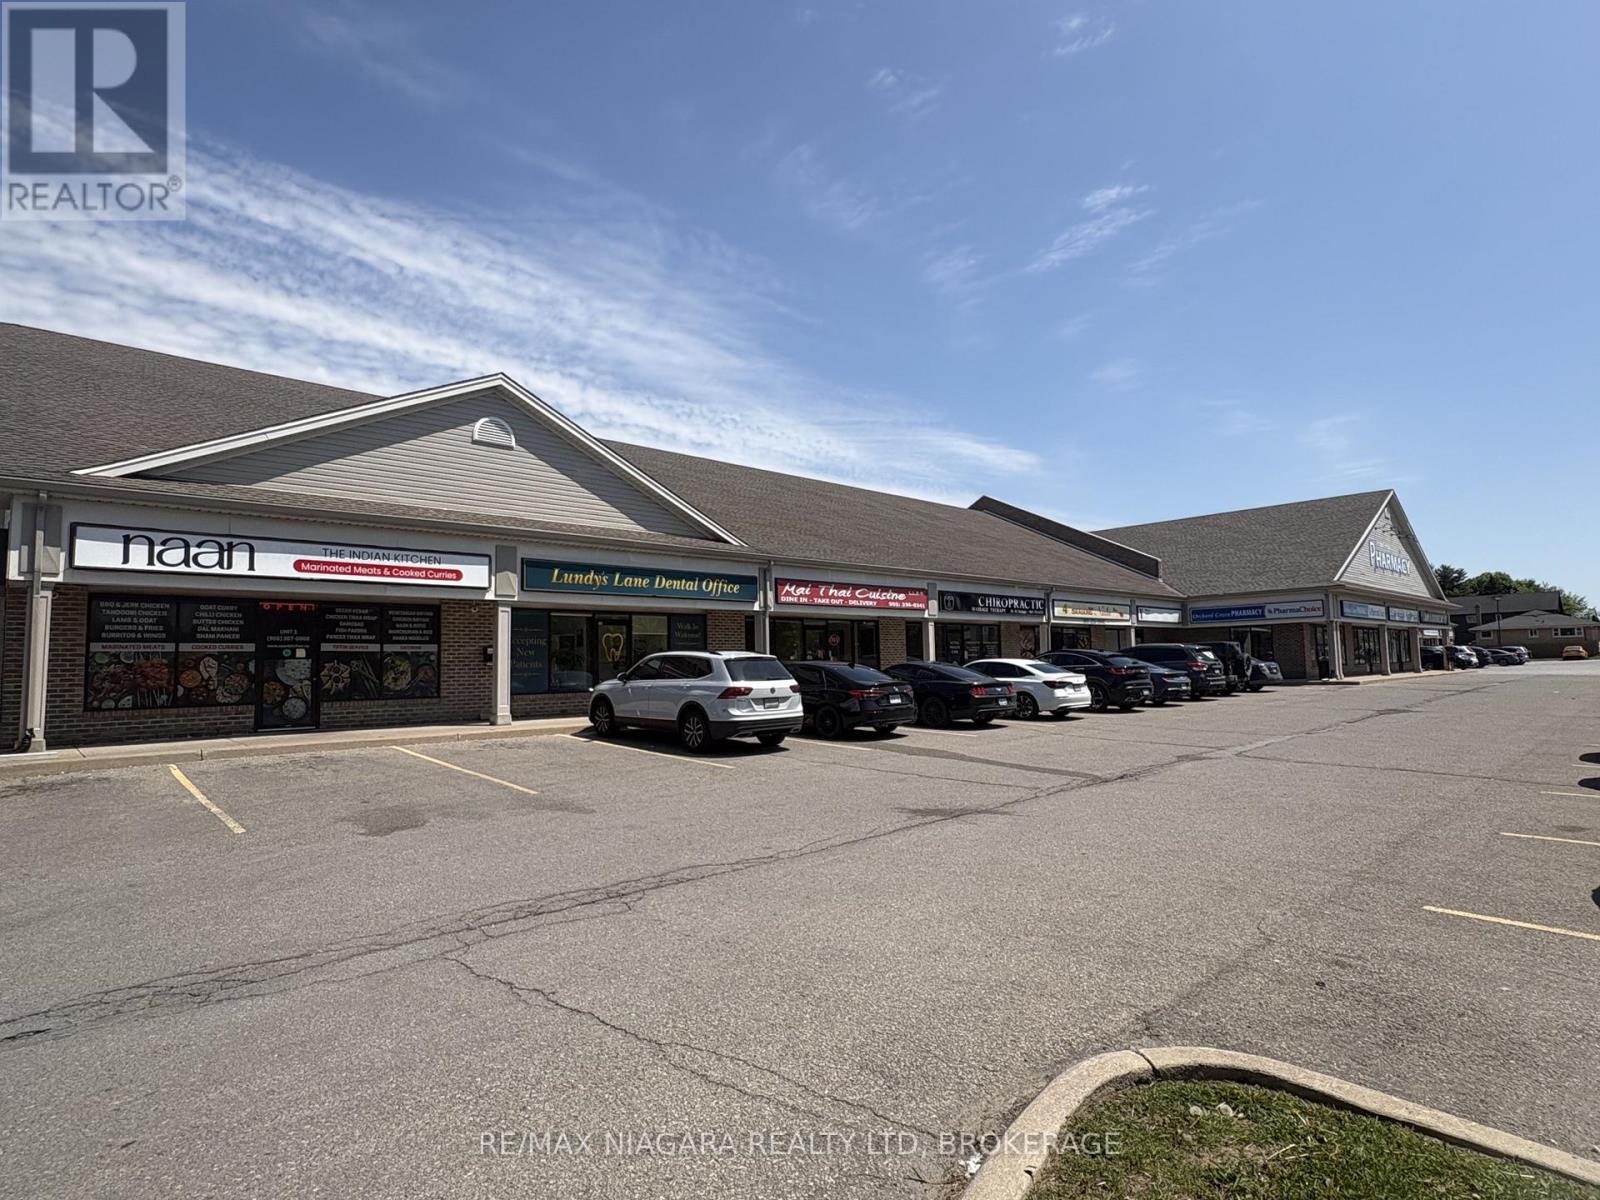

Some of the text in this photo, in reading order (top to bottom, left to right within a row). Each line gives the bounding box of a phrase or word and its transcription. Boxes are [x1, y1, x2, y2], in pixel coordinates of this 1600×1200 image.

[122, 534, 256, 571] naan
[322, 548, 442, 565] THE INDIAN KITCHEN
[1368, 541, 1410, 575] PHARMACY
[301, 562, 456, 580] Marinated Meats & Cooked Curries
[551, 568, 740, 597] Lundy's Lane Dental Office
[781, 582, 906, 601] Mai Thai Cuisine
[978, 596, 1045, 610] CHIROPRACTIC
[1231, 608, 1262, 617] PHARMACY
